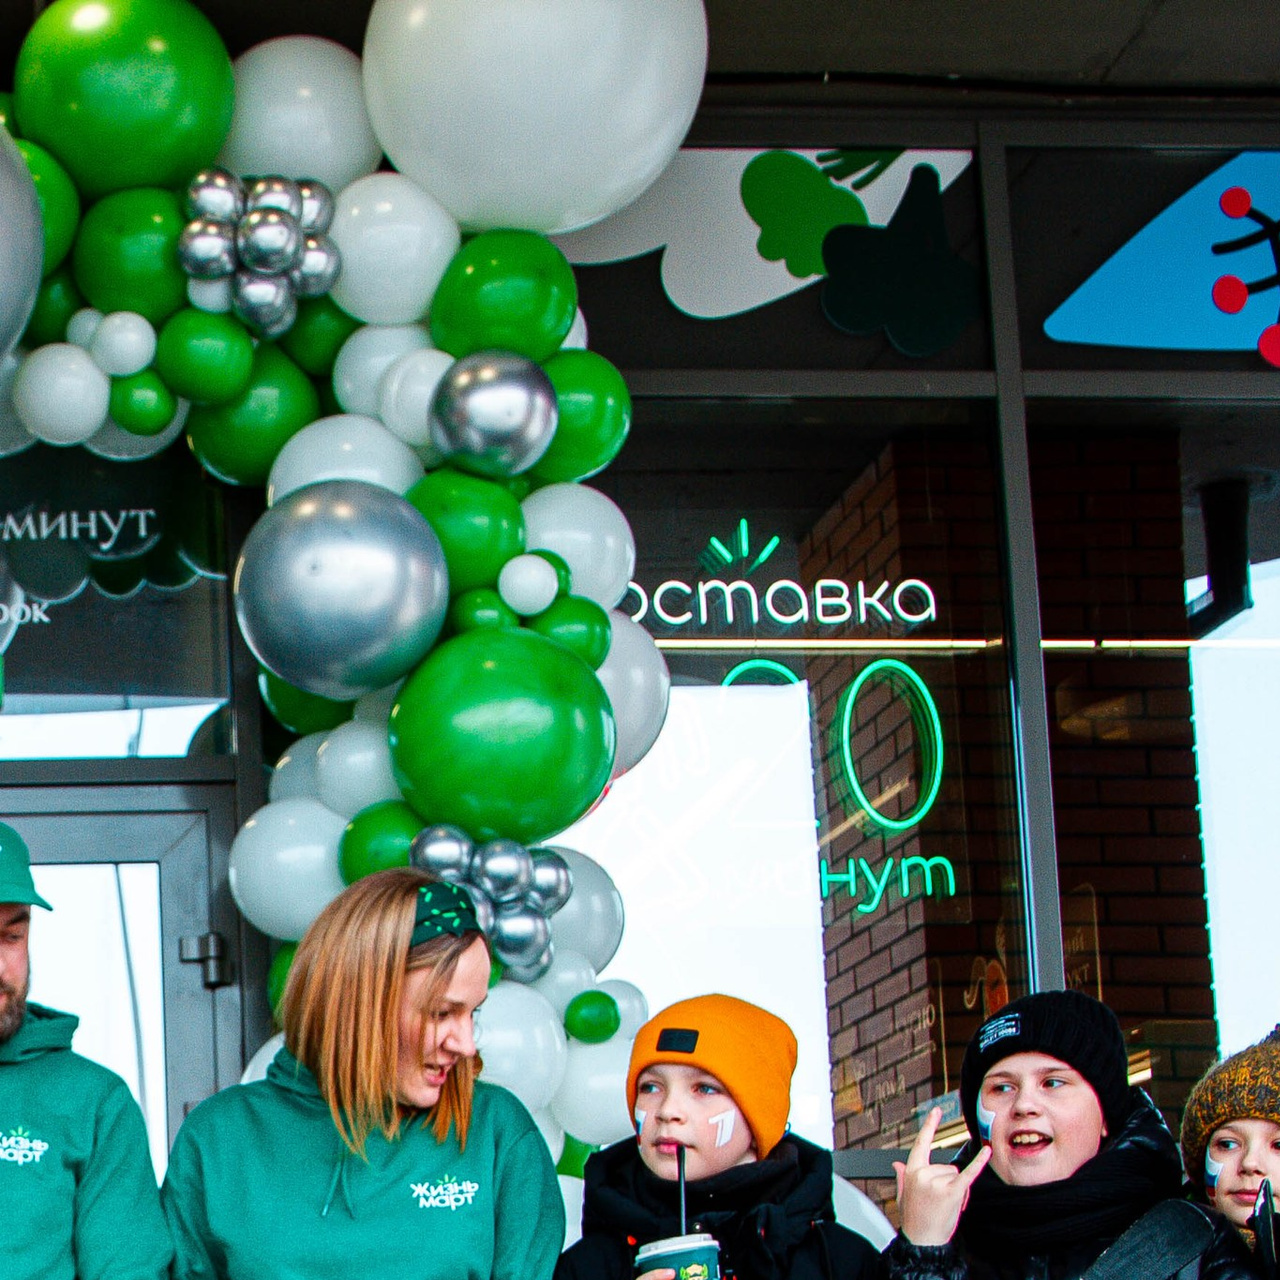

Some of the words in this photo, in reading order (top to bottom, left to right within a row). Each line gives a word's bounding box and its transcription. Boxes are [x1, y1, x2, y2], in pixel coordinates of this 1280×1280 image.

[2, 508, 156, 552] минут
[627, 578, 937, 625] оставка
[820, 855, 956, 914] нут
